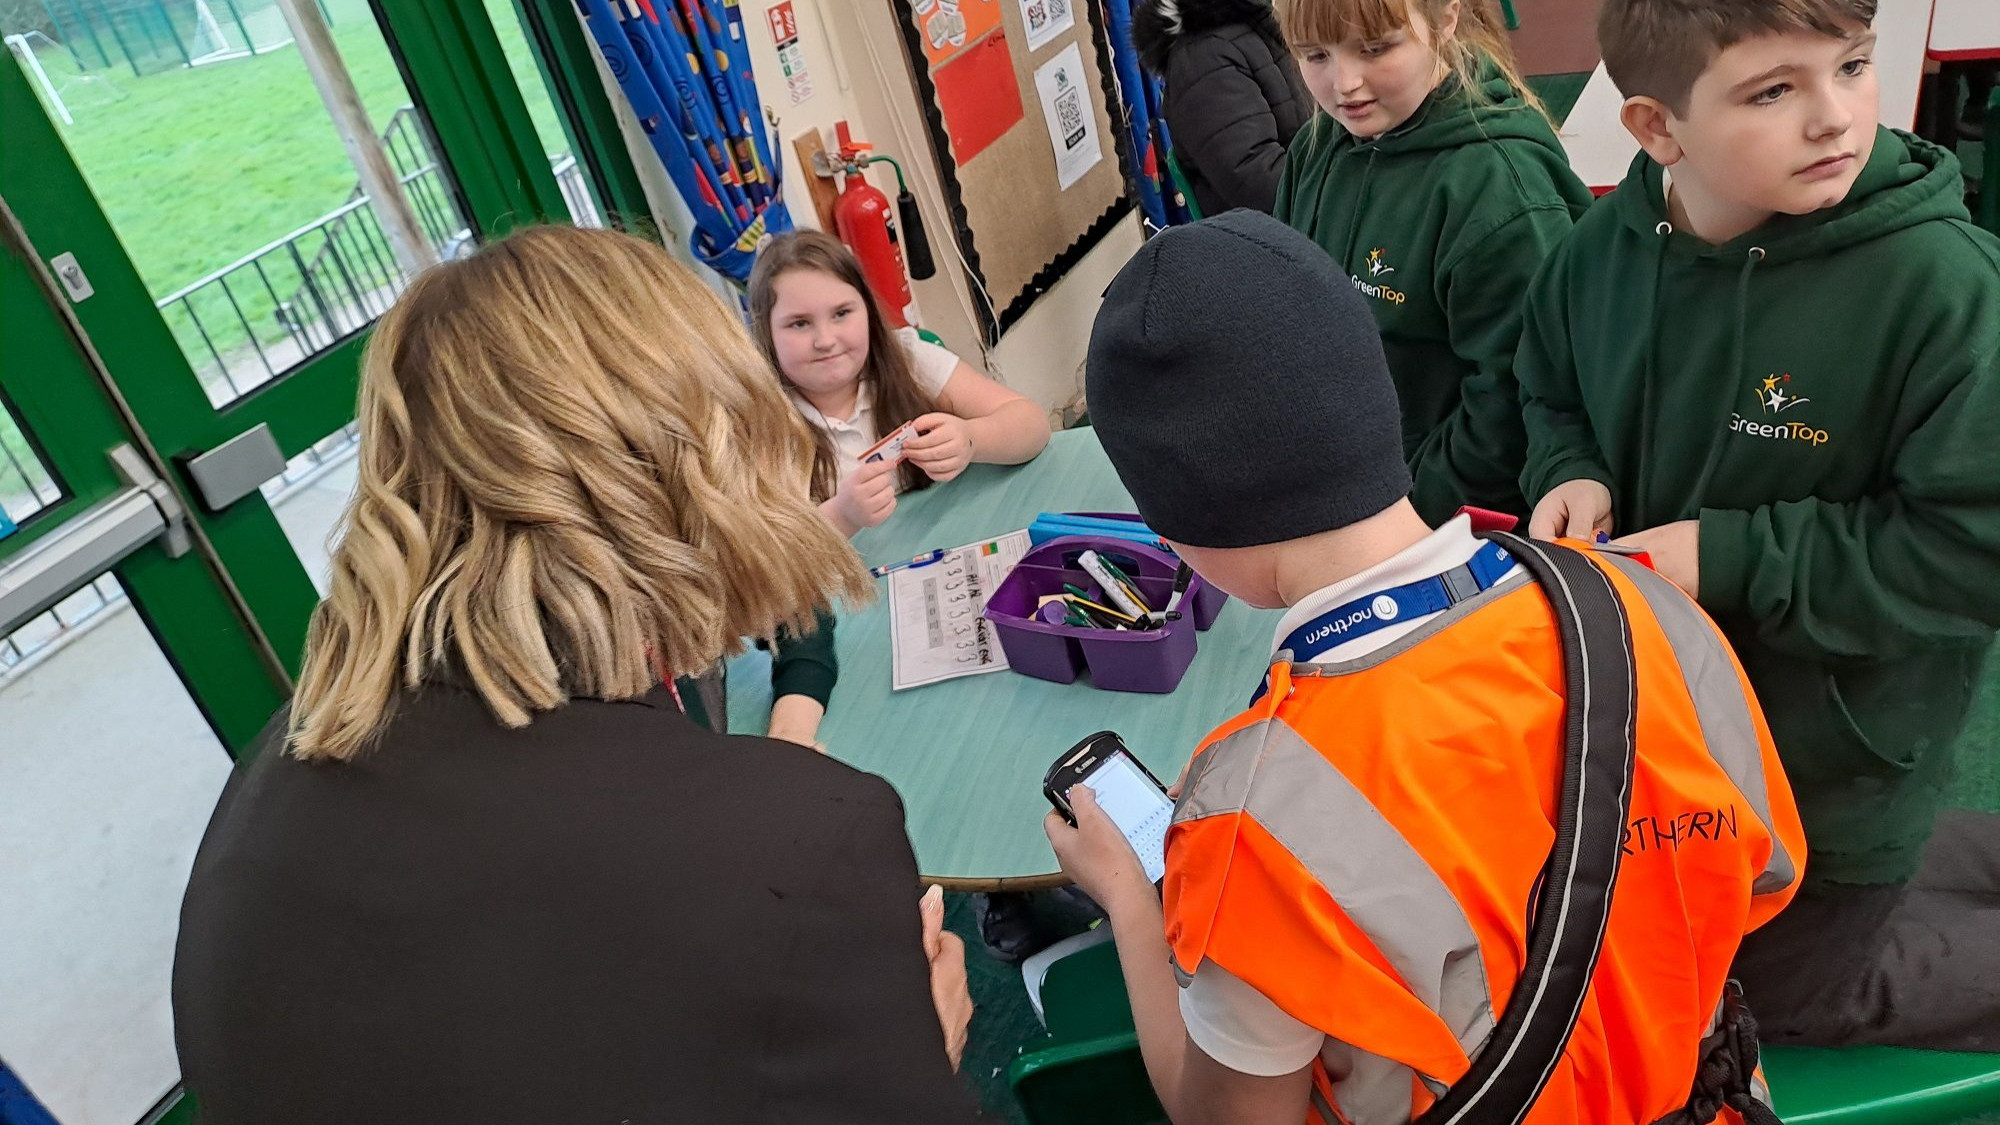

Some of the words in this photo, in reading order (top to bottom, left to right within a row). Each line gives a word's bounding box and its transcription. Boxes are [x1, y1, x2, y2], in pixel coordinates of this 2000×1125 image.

[1351, 274, 1405, 305] GreenTop
[1729, 412, 1829, 447] GreenTop
[1305, 608, 1372, 644] northern
